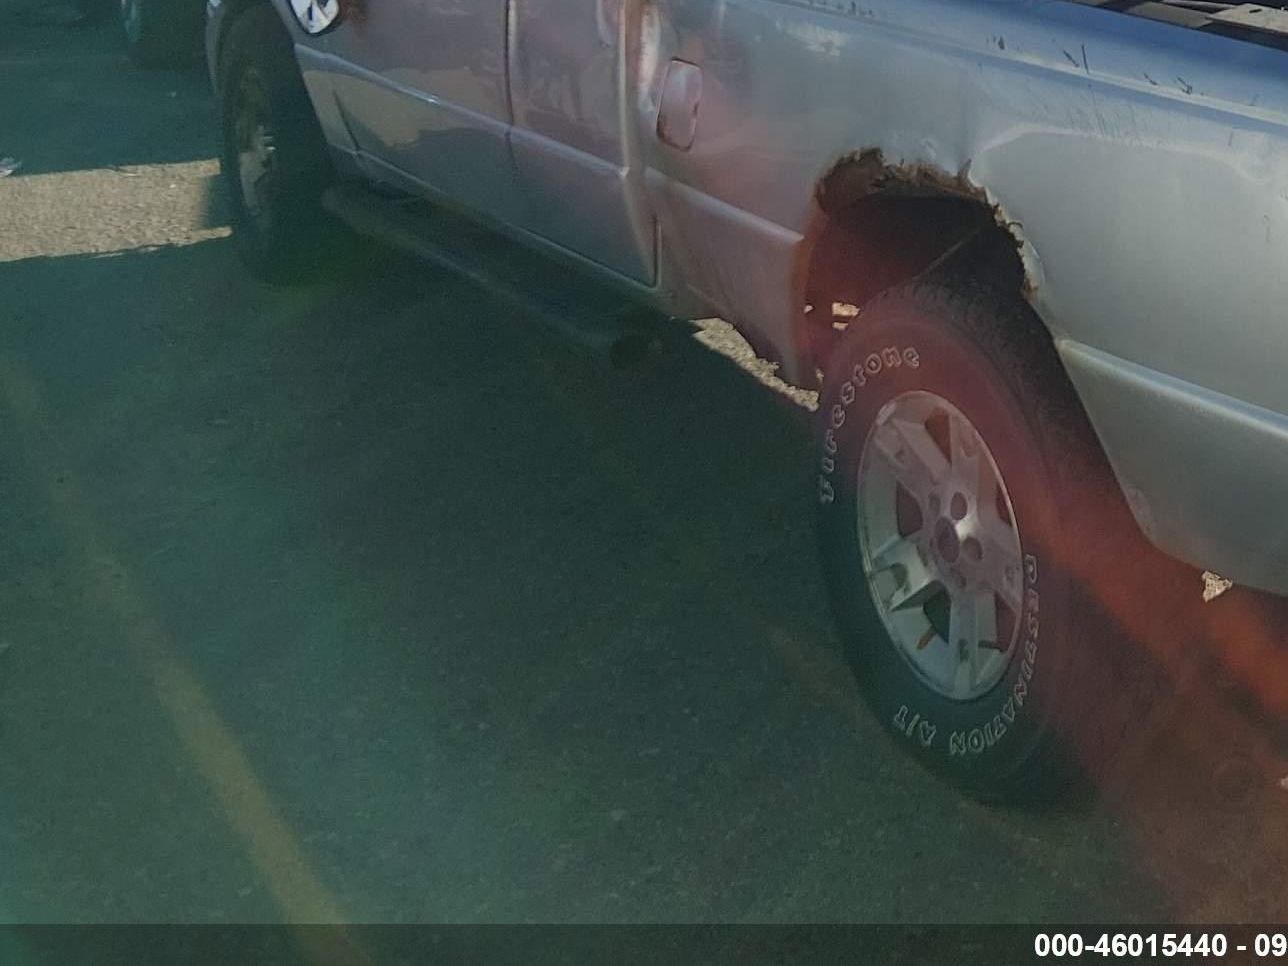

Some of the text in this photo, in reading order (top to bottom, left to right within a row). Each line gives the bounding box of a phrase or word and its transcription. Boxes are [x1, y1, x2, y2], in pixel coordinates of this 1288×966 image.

[819, 346, 920, 505] Firestone
[894, 554, 1040, 756] DESTINATION A/T
